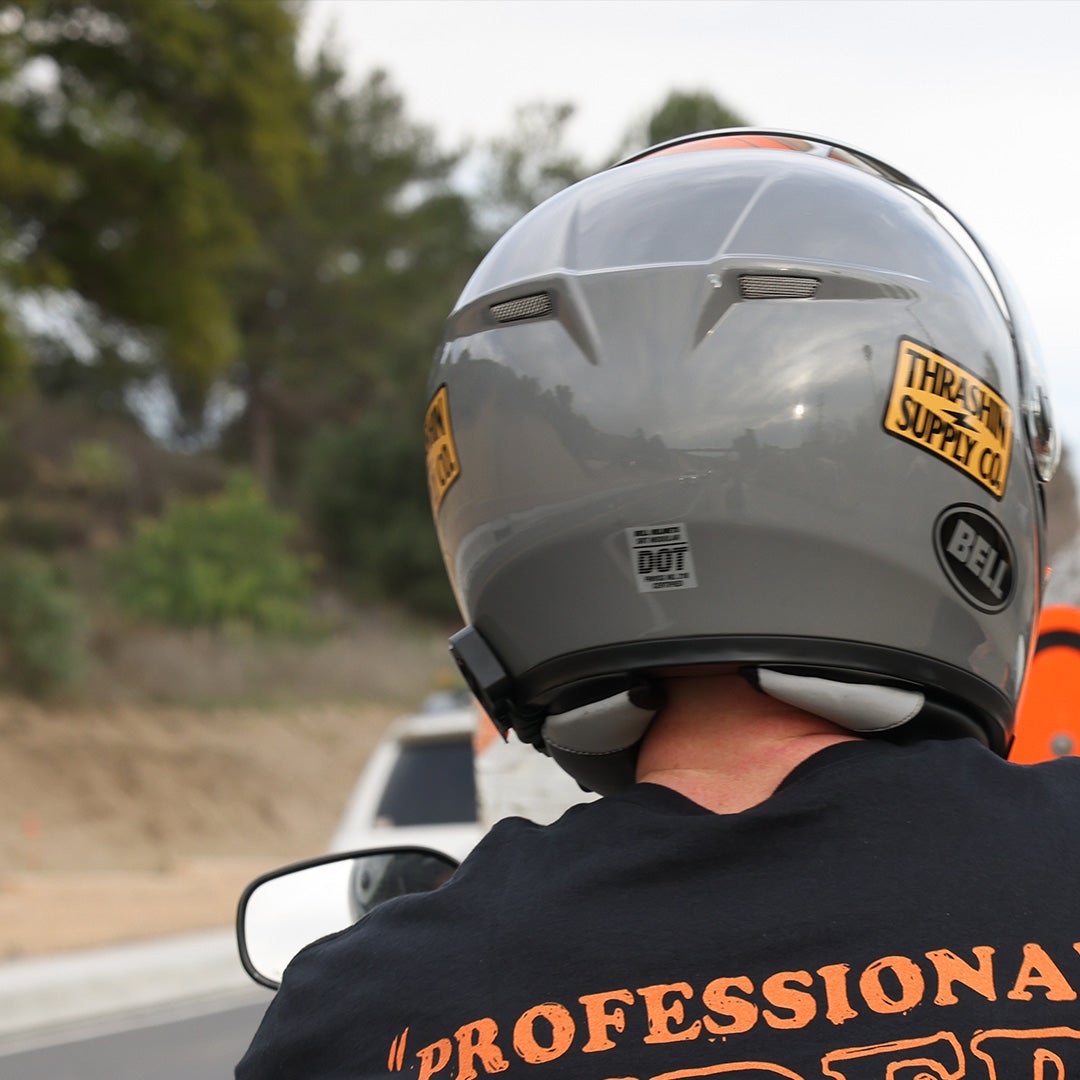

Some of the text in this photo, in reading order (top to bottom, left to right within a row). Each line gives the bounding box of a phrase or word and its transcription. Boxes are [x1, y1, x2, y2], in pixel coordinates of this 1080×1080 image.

[896, 394, 978, 467] SUPPLY
[905, 348, 1009, 448] THRASHIN
[637, 546, 689, 575] DOT
[946, 519, 1009, 600] BELL
